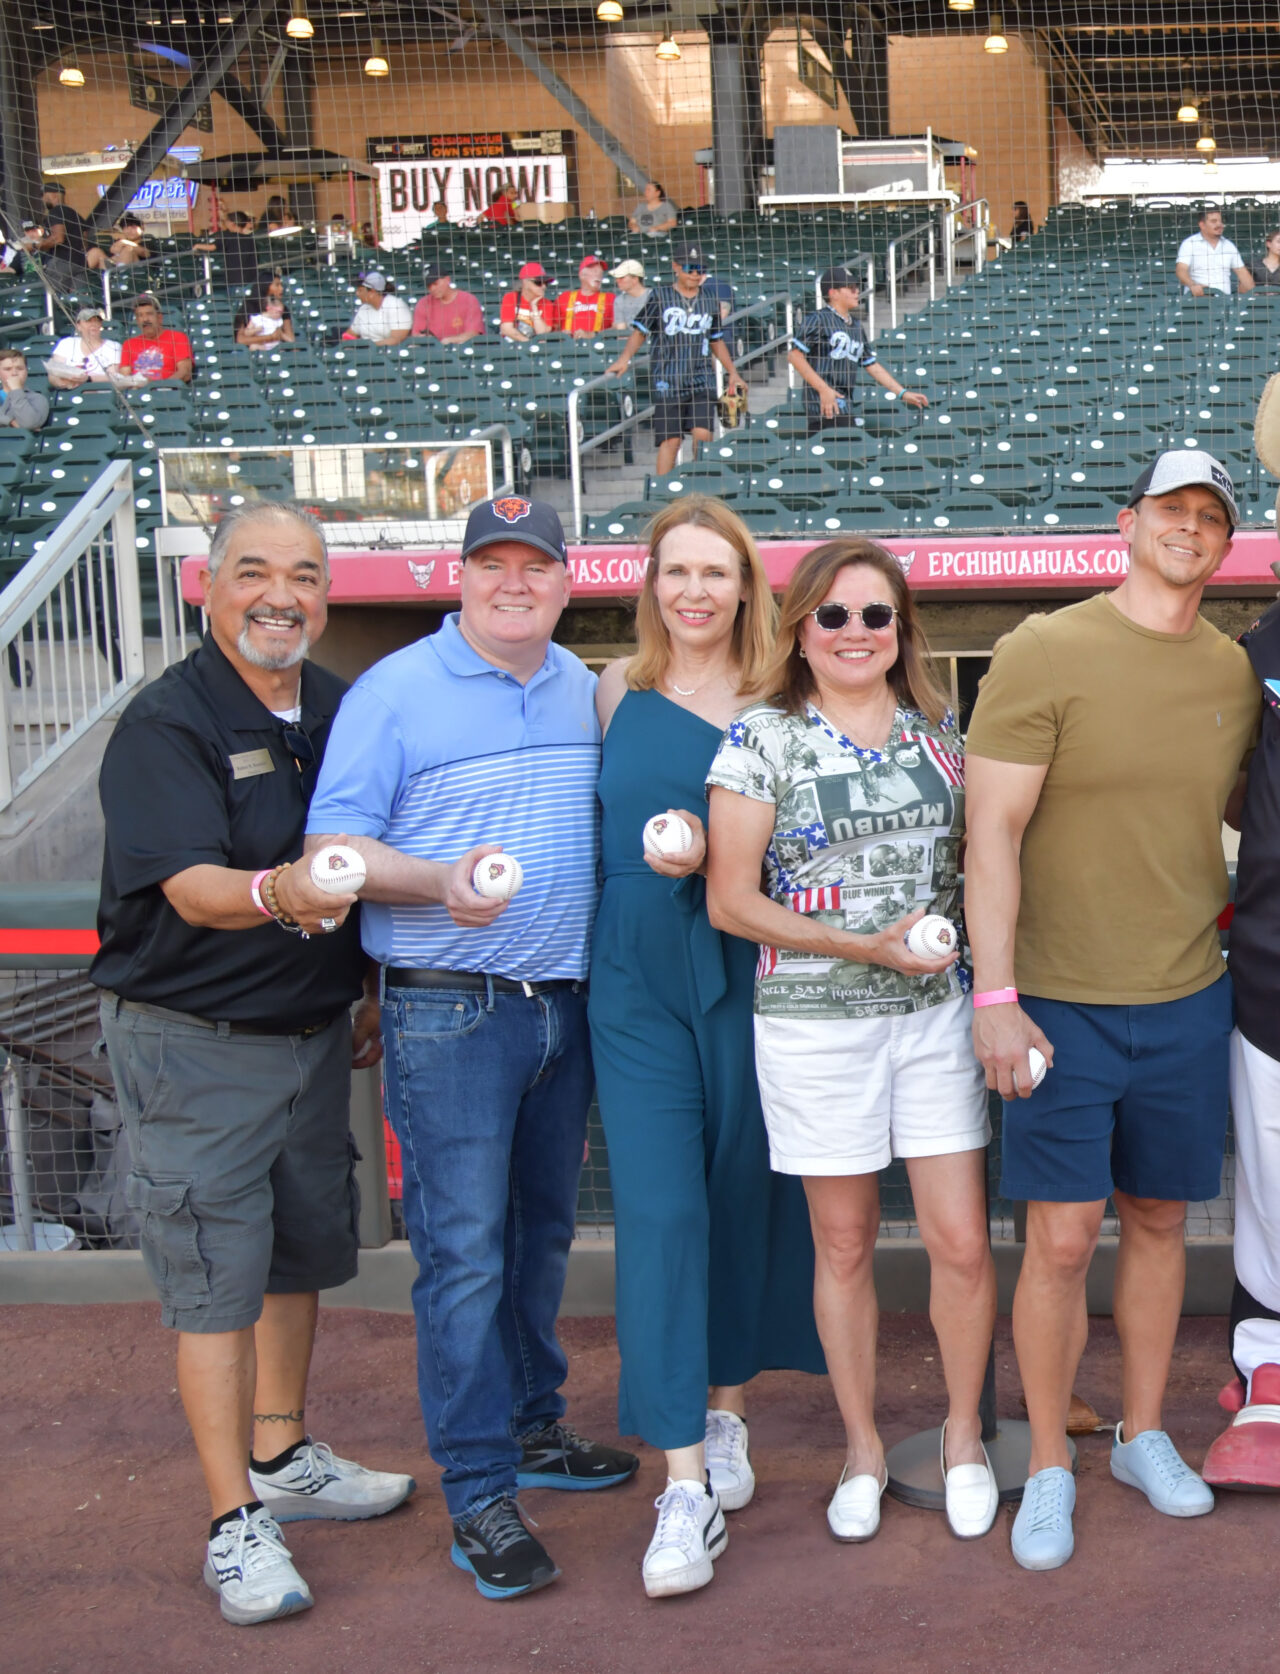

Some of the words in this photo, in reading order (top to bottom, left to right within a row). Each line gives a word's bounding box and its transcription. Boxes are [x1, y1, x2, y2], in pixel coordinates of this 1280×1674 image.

[431, 137, 472, 147] DESIGN
[473, 135, 503, 145] YOUR
[431, 147, 460, 157] OWN
[462, 145, 505, 156] SYSTEM
[389, 166, 452, 213] BUY
[463, 164, 552, 212] NOW!
[832, 802, 945, 841] MALIBU
[842, 889, 862, 900] BLUE
[863, 886, 895, 897] WINNER
[761, 985, 790, 996] NCLE
